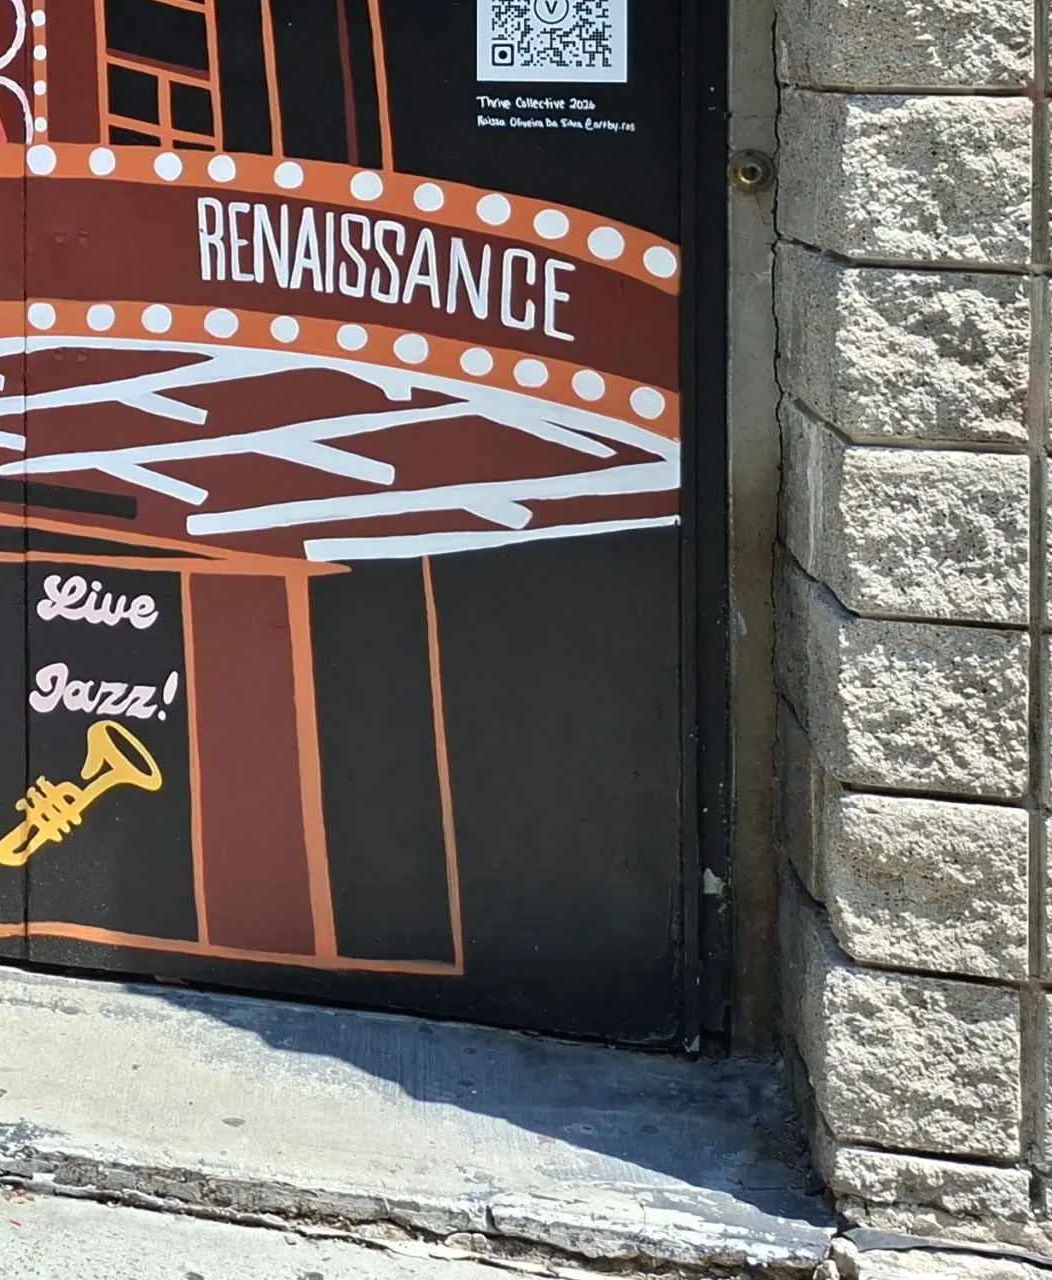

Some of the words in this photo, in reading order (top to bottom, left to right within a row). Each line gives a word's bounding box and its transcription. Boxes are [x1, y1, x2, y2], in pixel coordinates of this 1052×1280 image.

[476, 96, 511, 110] Thrive
[515, 96, 565, 110] Collective
[569, 97, 596, 110] 2026
[509, 117, 544, 128] Oliveira
[545, 117, 558, 128] Da
[560, 118, 583, 129] Silva
[198, 196, 576, 342] RENAISSANCE
[36, 574, 159, 629] Live
[28, 662, 179, 721] Jazz!
